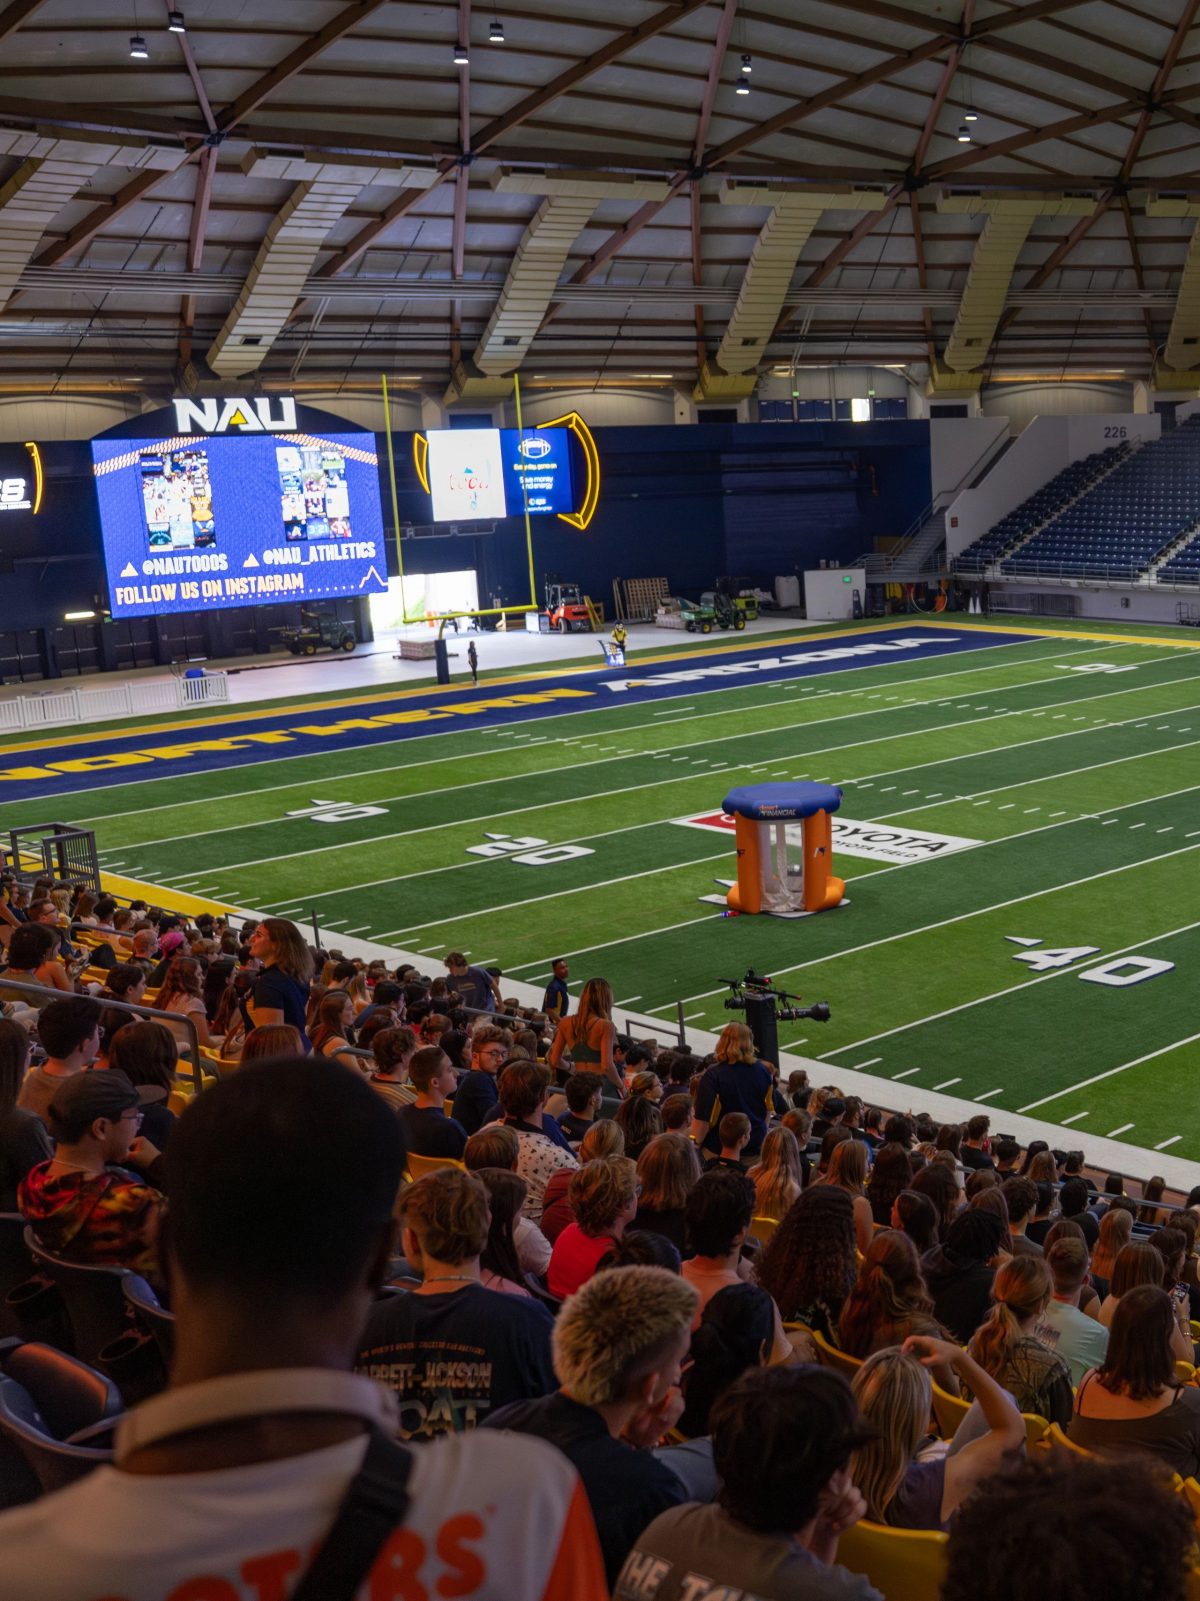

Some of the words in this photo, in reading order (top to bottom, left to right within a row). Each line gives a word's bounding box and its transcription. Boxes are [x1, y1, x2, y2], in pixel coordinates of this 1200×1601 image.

[172, 396, 298, 433] NAU
[1104, 427, 1127, 438] 226
[142, 553, 228, 576] @NAU7000S
[263, 541, 376, 565] @NAU_ATHLETICS
[116, 586, 176, 605] FOLLOW
[181, 582, 200, 599] US
[202, 579, 222, 597] ON
[224, 573, 304, 596] INSTAGRAM
[598, 637, 962, 692] ARIZONA
[832, 824, 950, 853] OYOTA
[880, 847, 919, 859] FIELD
